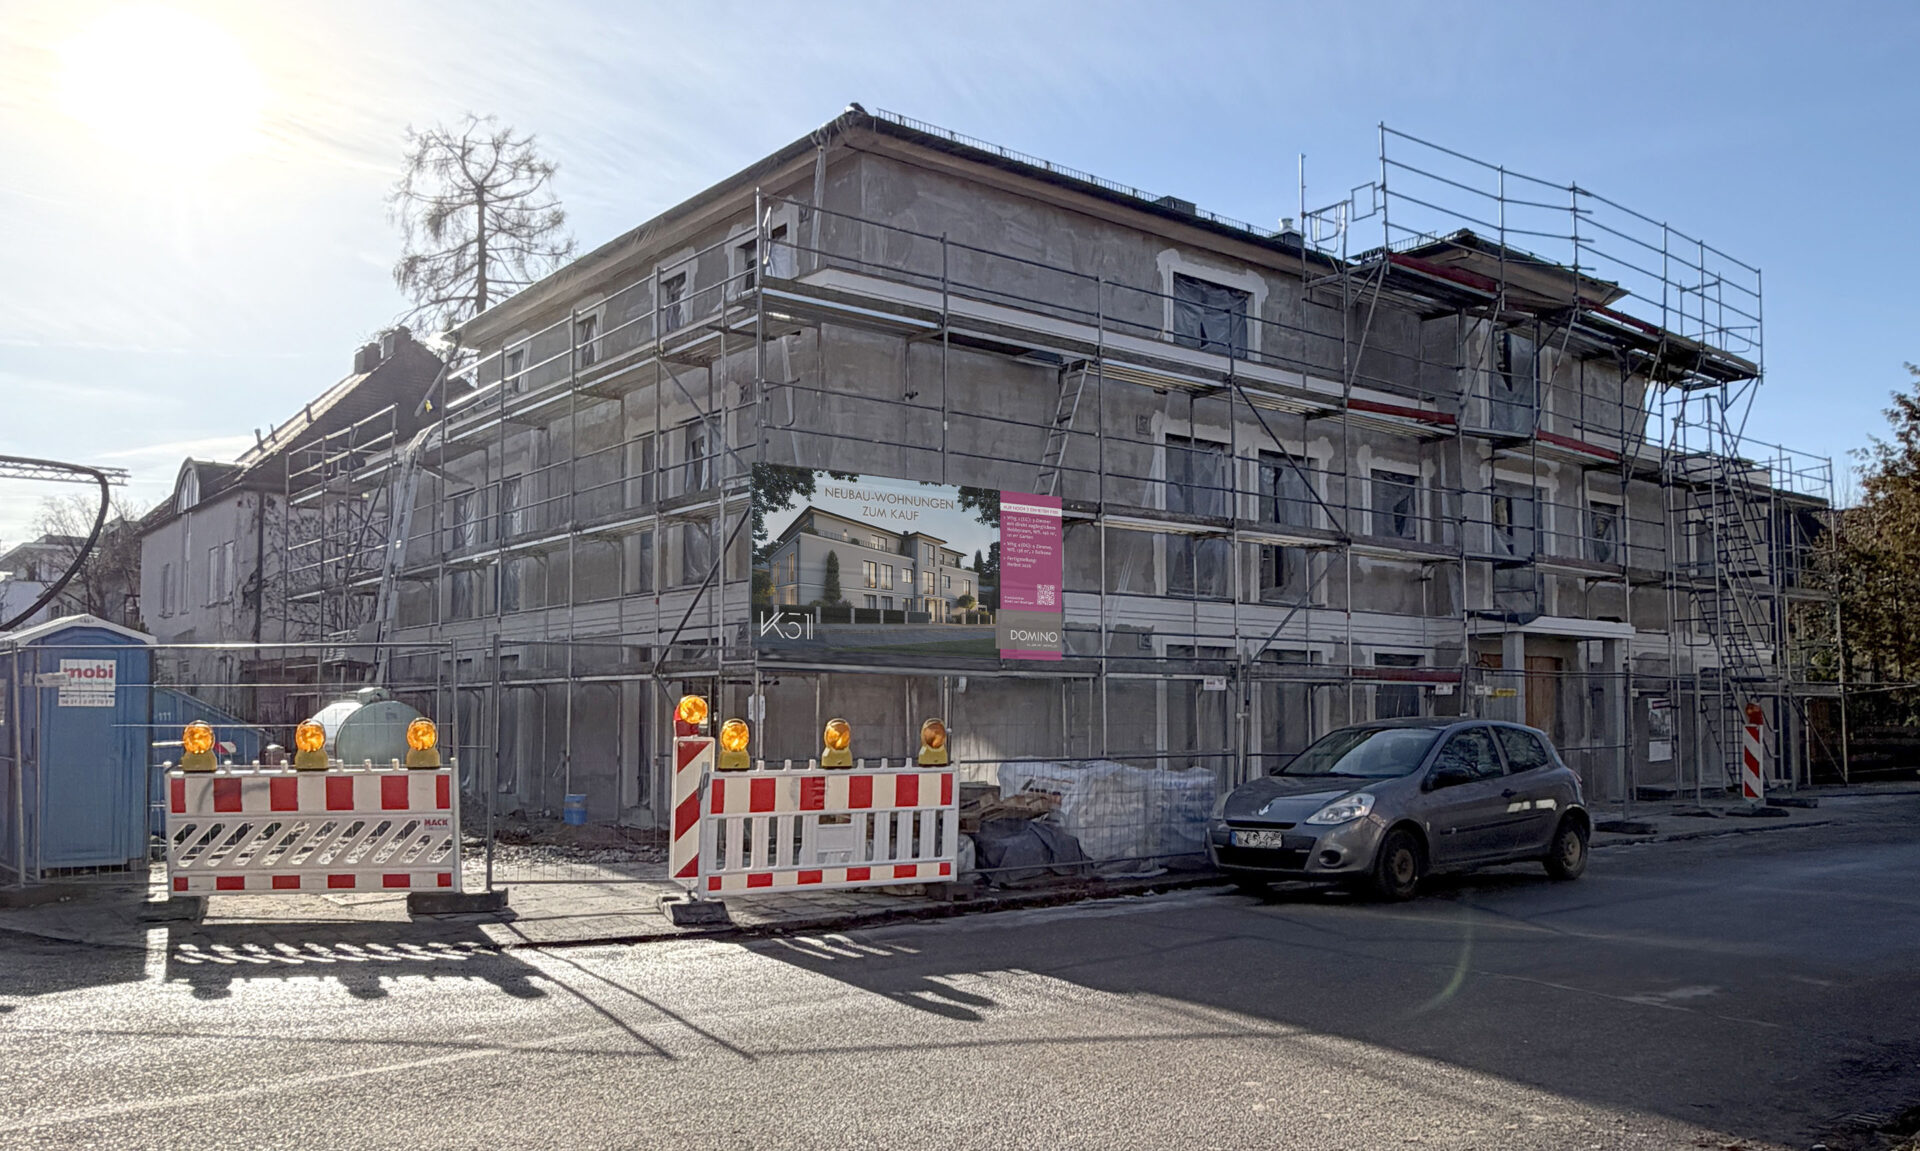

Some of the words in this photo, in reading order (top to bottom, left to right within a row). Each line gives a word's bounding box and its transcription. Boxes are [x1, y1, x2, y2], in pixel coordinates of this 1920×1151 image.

[825, 487, 954, 510] NEUBAU-WOHNUNGEN
[862, 506, 887, 518] ZUM
[890, 509, 920, 521] KAUF
[1010, 629, 1058, 642] DOMINO
[63, 664, 113, 679] mobi
